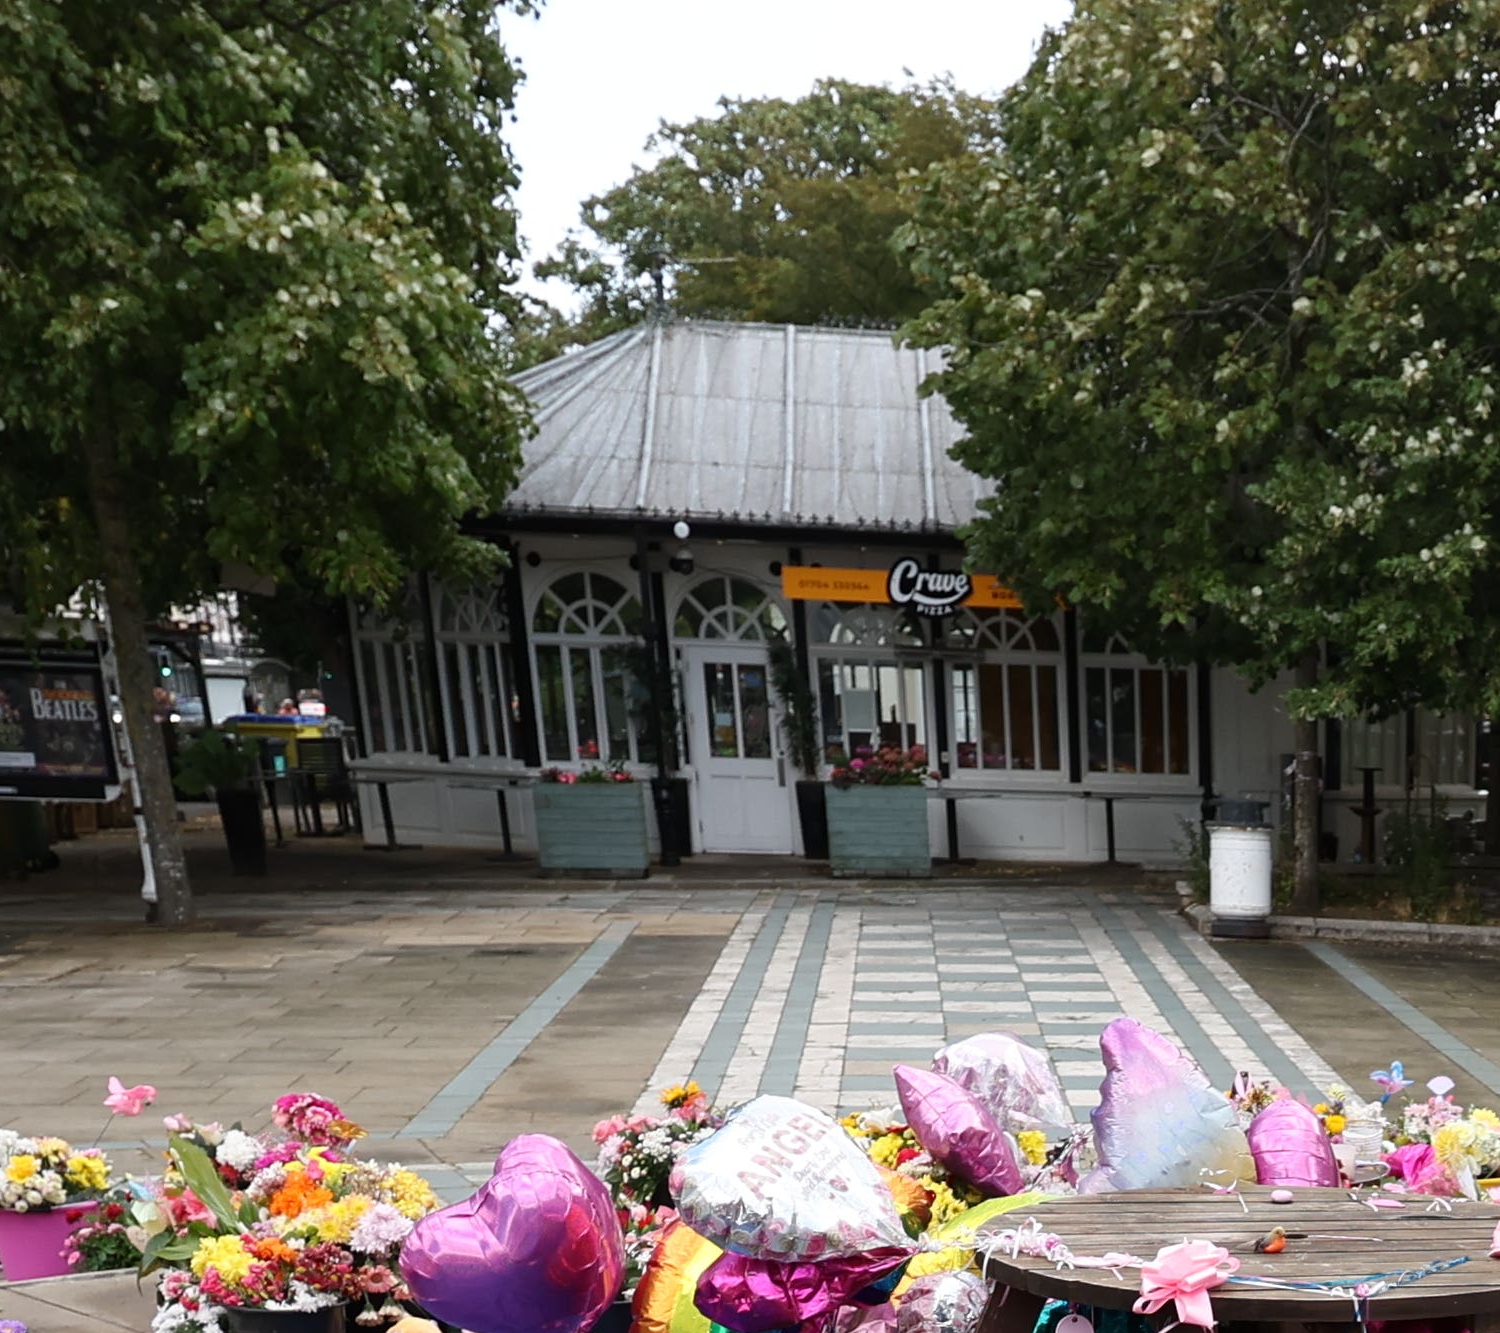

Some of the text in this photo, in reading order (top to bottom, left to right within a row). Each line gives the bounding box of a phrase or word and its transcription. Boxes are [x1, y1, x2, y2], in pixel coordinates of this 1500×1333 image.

[890, 559, 971, 604] Crave
[916, 603, 953, 616] PIZZA
[28, 687, 100, 723] BEATLES
